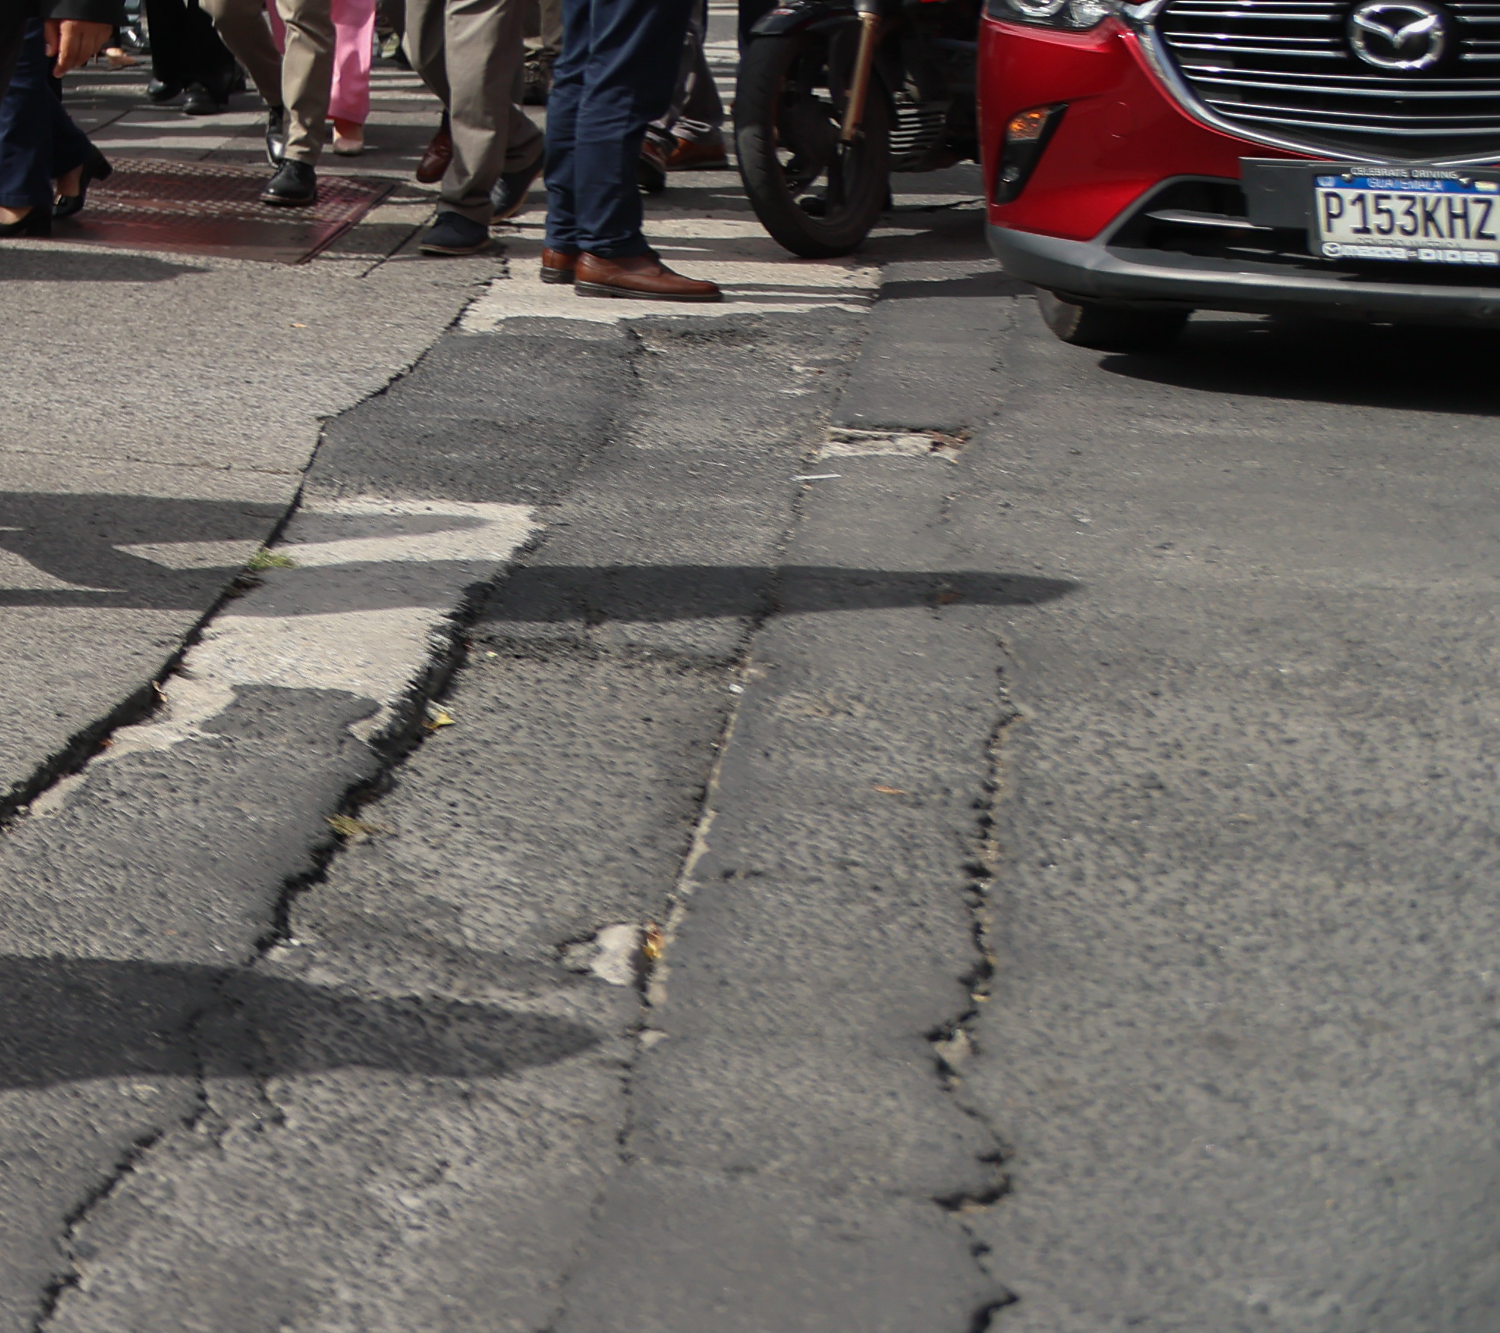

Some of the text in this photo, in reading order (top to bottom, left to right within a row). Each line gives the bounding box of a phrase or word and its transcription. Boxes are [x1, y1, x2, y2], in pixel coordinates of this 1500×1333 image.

[1350, 167, 1459, 179] CELEBRATE DRIVING
[1367, 177, 1443, 190] GUATEMALA
